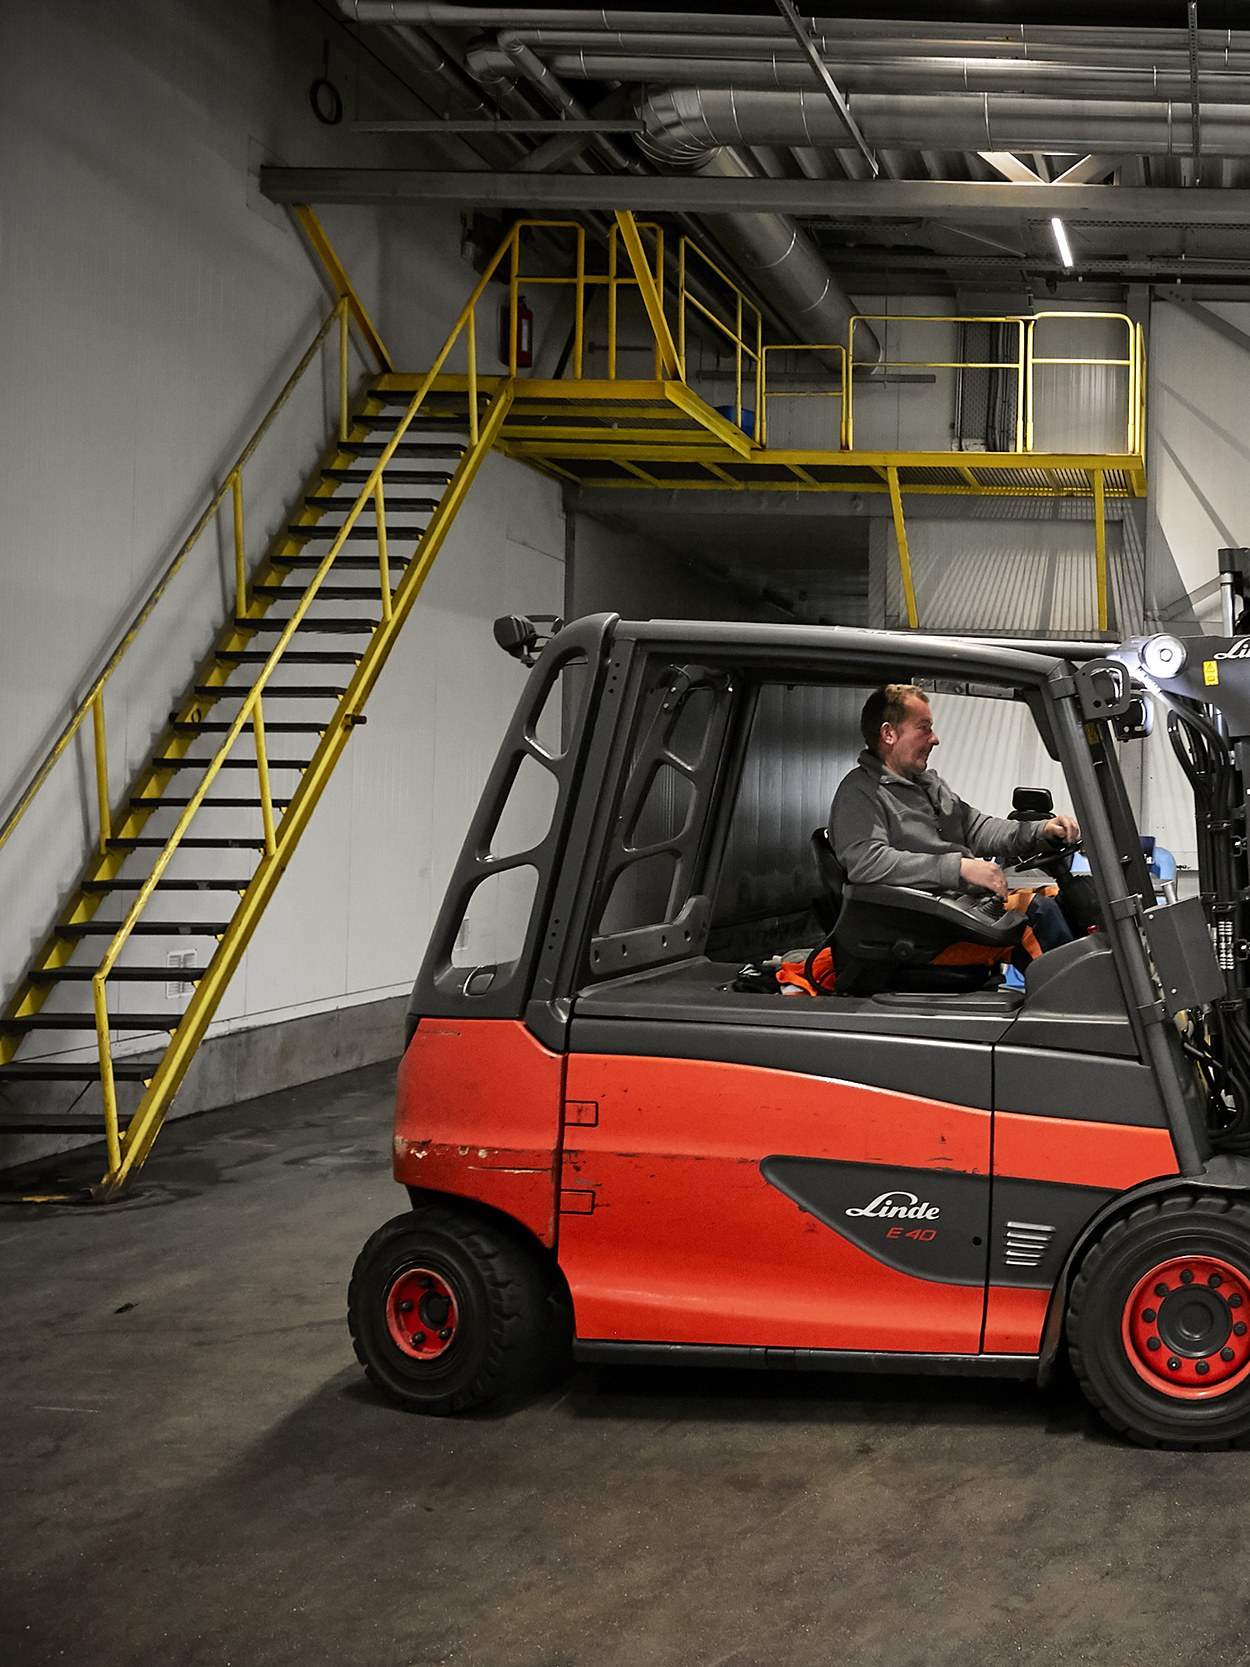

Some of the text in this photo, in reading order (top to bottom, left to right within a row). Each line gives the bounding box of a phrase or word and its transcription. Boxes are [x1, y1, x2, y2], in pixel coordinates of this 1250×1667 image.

[845, 1191, 940, 1220] Linde
[886, 1227, 937, 1241] E 40
